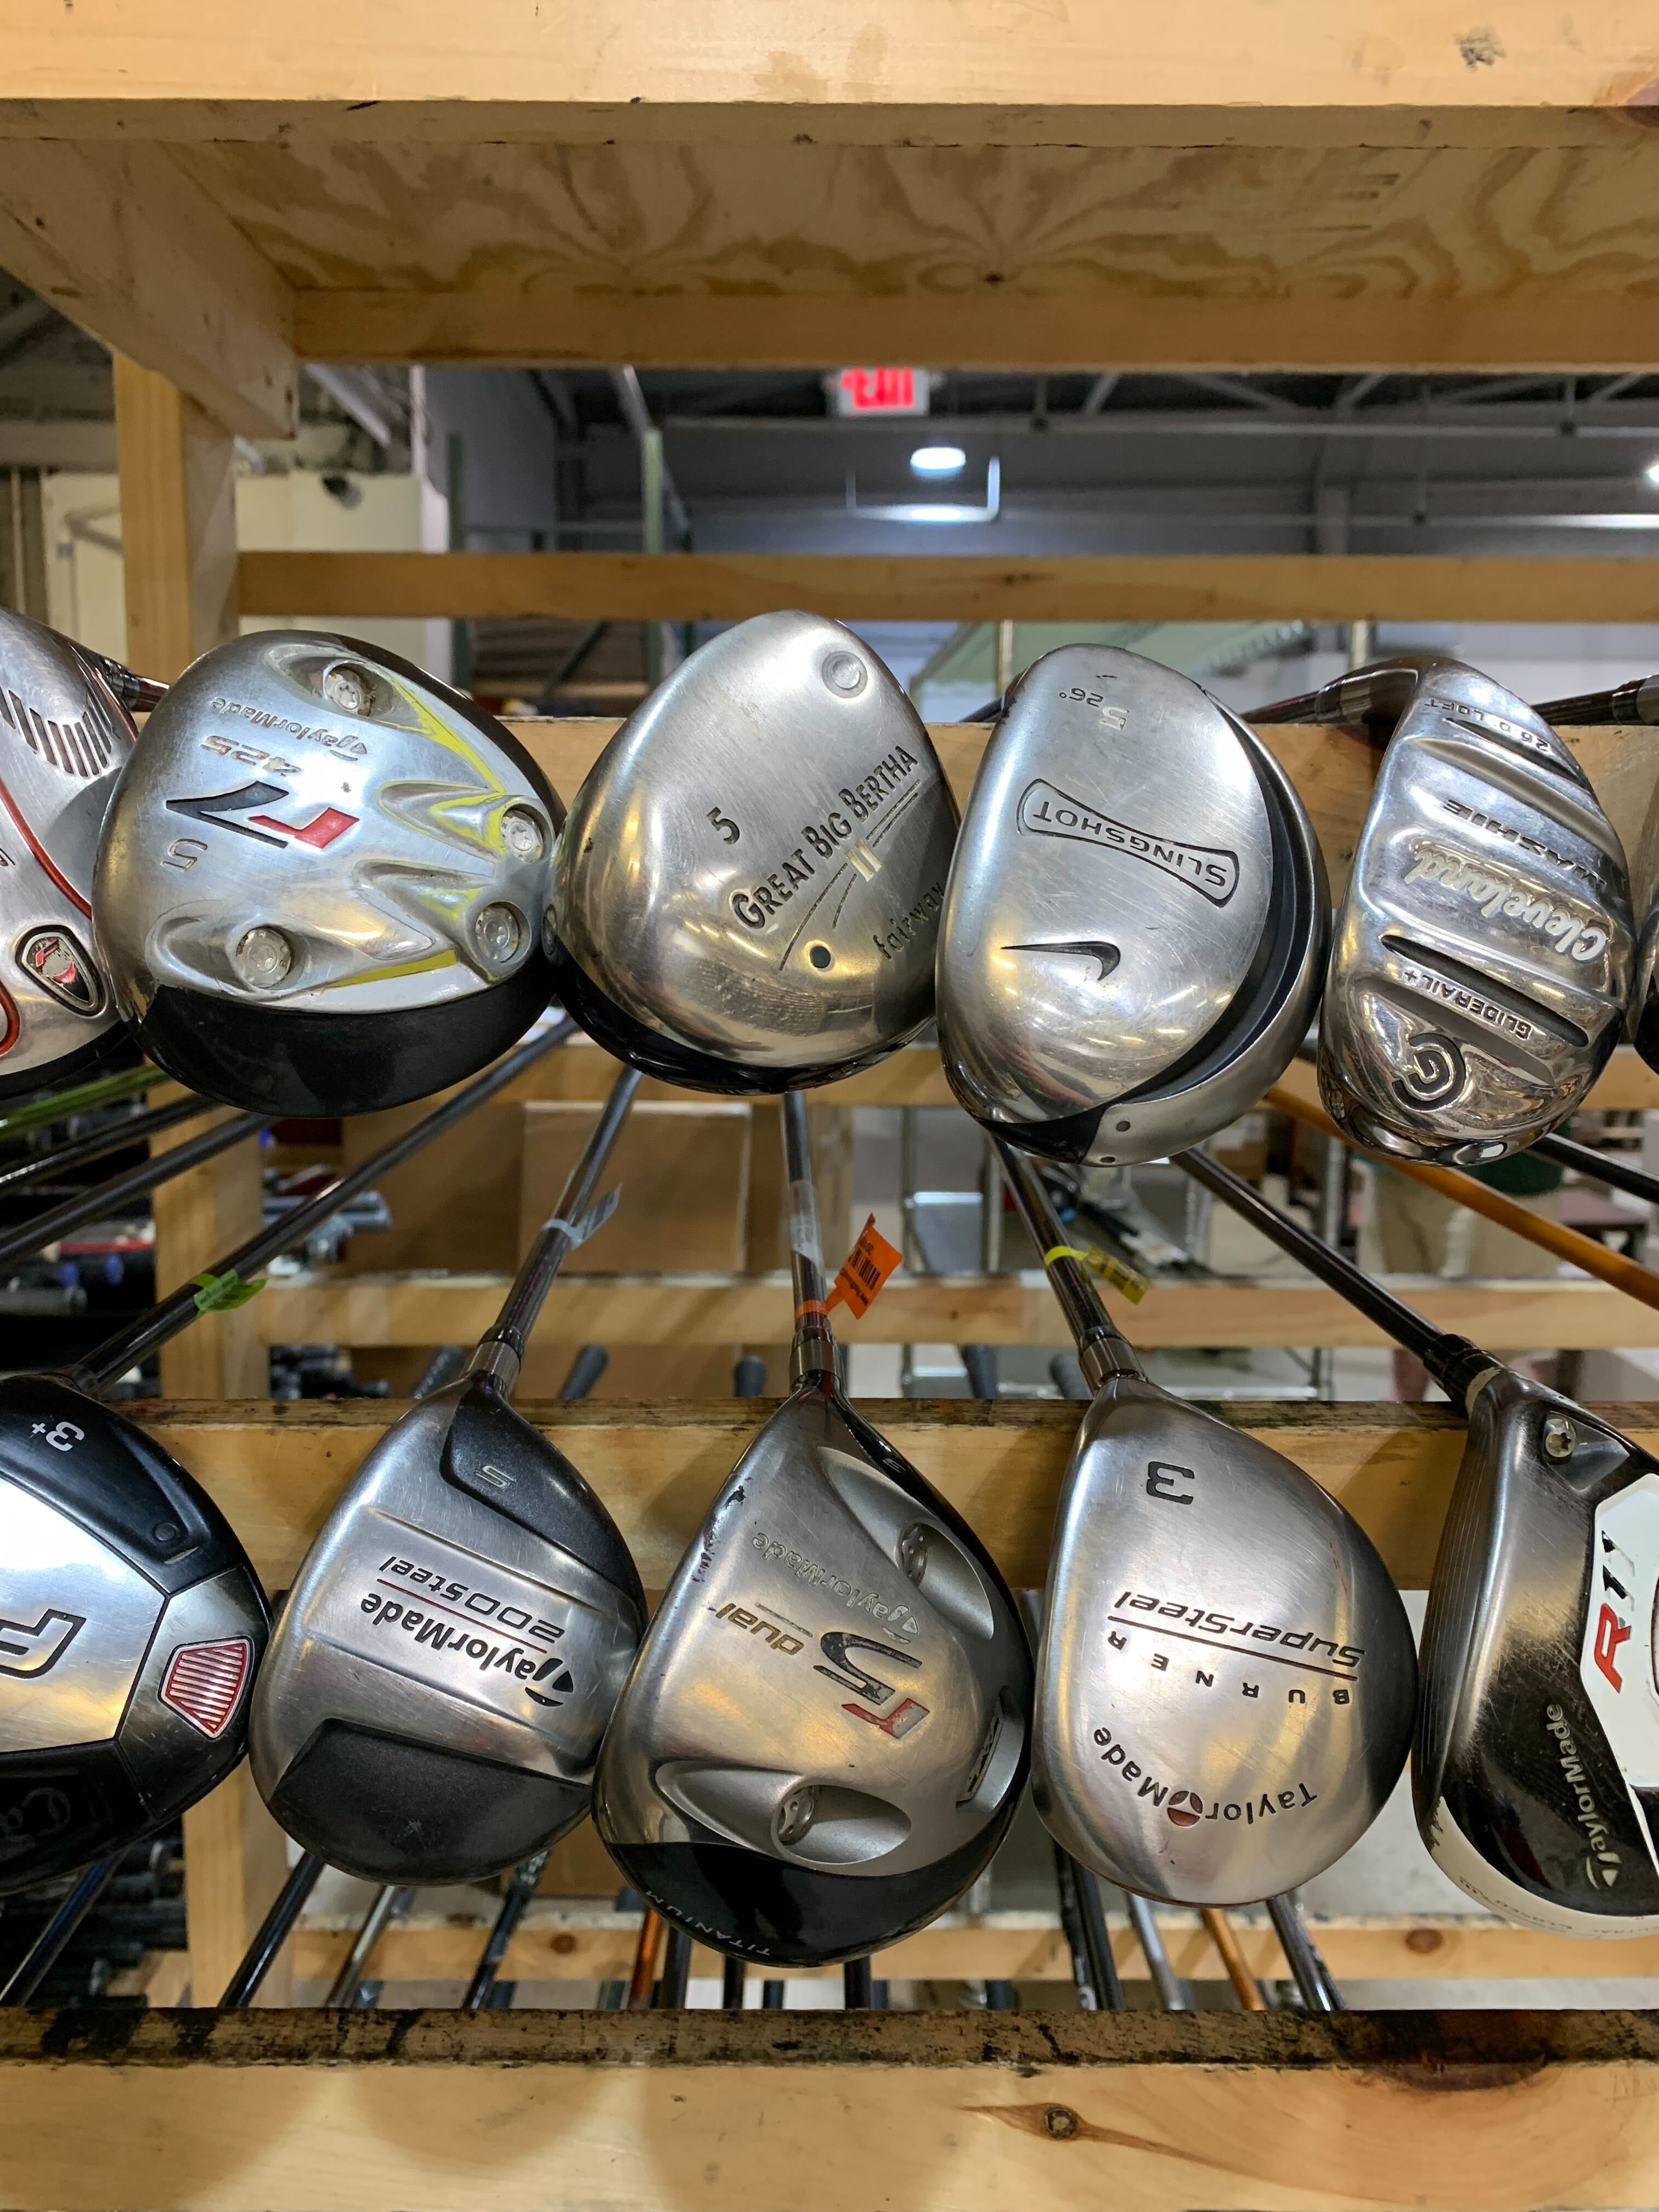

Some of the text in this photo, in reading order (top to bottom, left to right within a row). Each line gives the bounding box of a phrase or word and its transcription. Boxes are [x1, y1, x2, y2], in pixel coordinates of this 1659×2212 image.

[211, 697, 367, 761] TaylorMade
[1103, 705, 1130, 730] 5
[1425, 698, 1484, 721] LOFT
[201, 735, 301, 775] 425
[161, 838, 208, 872] 5
[707, 806, 740, 845] 5
[732, 746, 918, 930] GREAT BIG BERTHA
[1033, 800, 1228, 885] SLINGSHOT
[1443, 799, 1607, 886] MASHIE
[872, 882, 945, 960] fairway
[1404, 848, 1606, 962] Cleveland
[31, 1421, 85, 1452] 3+
[1146, 1460, 1195, 1505] 3
[752, 1532, 919, 1644] TaylorMade
[360, 1593, 574, 1707] TaylorMade
[715, 1602, 805, 1656] dual
[1114, 1591, 1367, 1668] SuperSteel
[1108, 1630, 1350, 1705] BURNER
[1546, 1703, 1622, 1890] TaylorMade
[645, 1889, 771, 1956] TITANIUM
